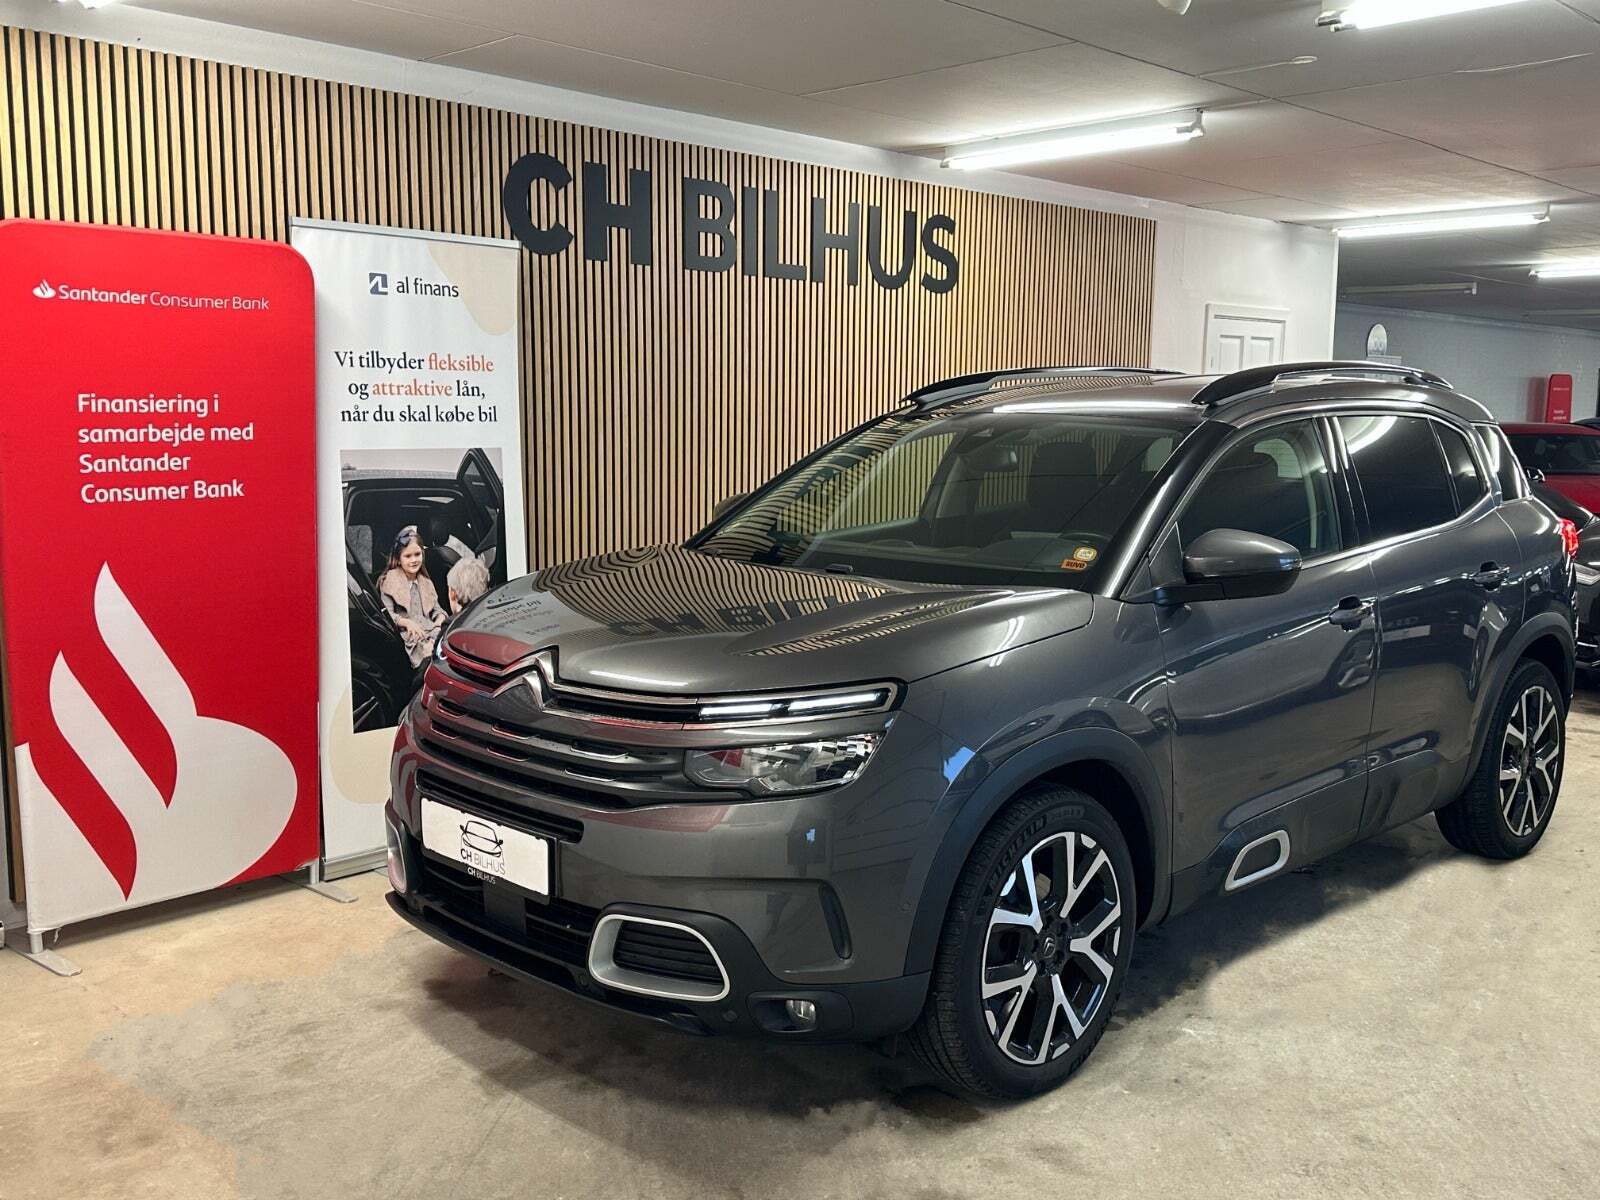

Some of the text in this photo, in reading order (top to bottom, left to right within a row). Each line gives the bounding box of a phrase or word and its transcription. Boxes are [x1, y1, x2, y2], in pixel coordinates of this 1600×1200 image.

[503, 152, 959, 294] CH BILHUS
[58, 284, 270, 311] Santander Consumer Bank
[396, 276, 459, 298] al finans
[334, 350, 494, 374] Vi tilbyder fleksible
[348, 379, 486, 400] og attraktive lån,
[77, 393, 219, 417] Finansiering i
[341, 404, 498, 422] når du skal købe bil
[78, 422, 254, 447] samarbejde med
[79, 453, 191, 474] Santander
[81, 479, 245, 503] Consumer Bank
[460, 848, 506, 875] CH BILHUS
